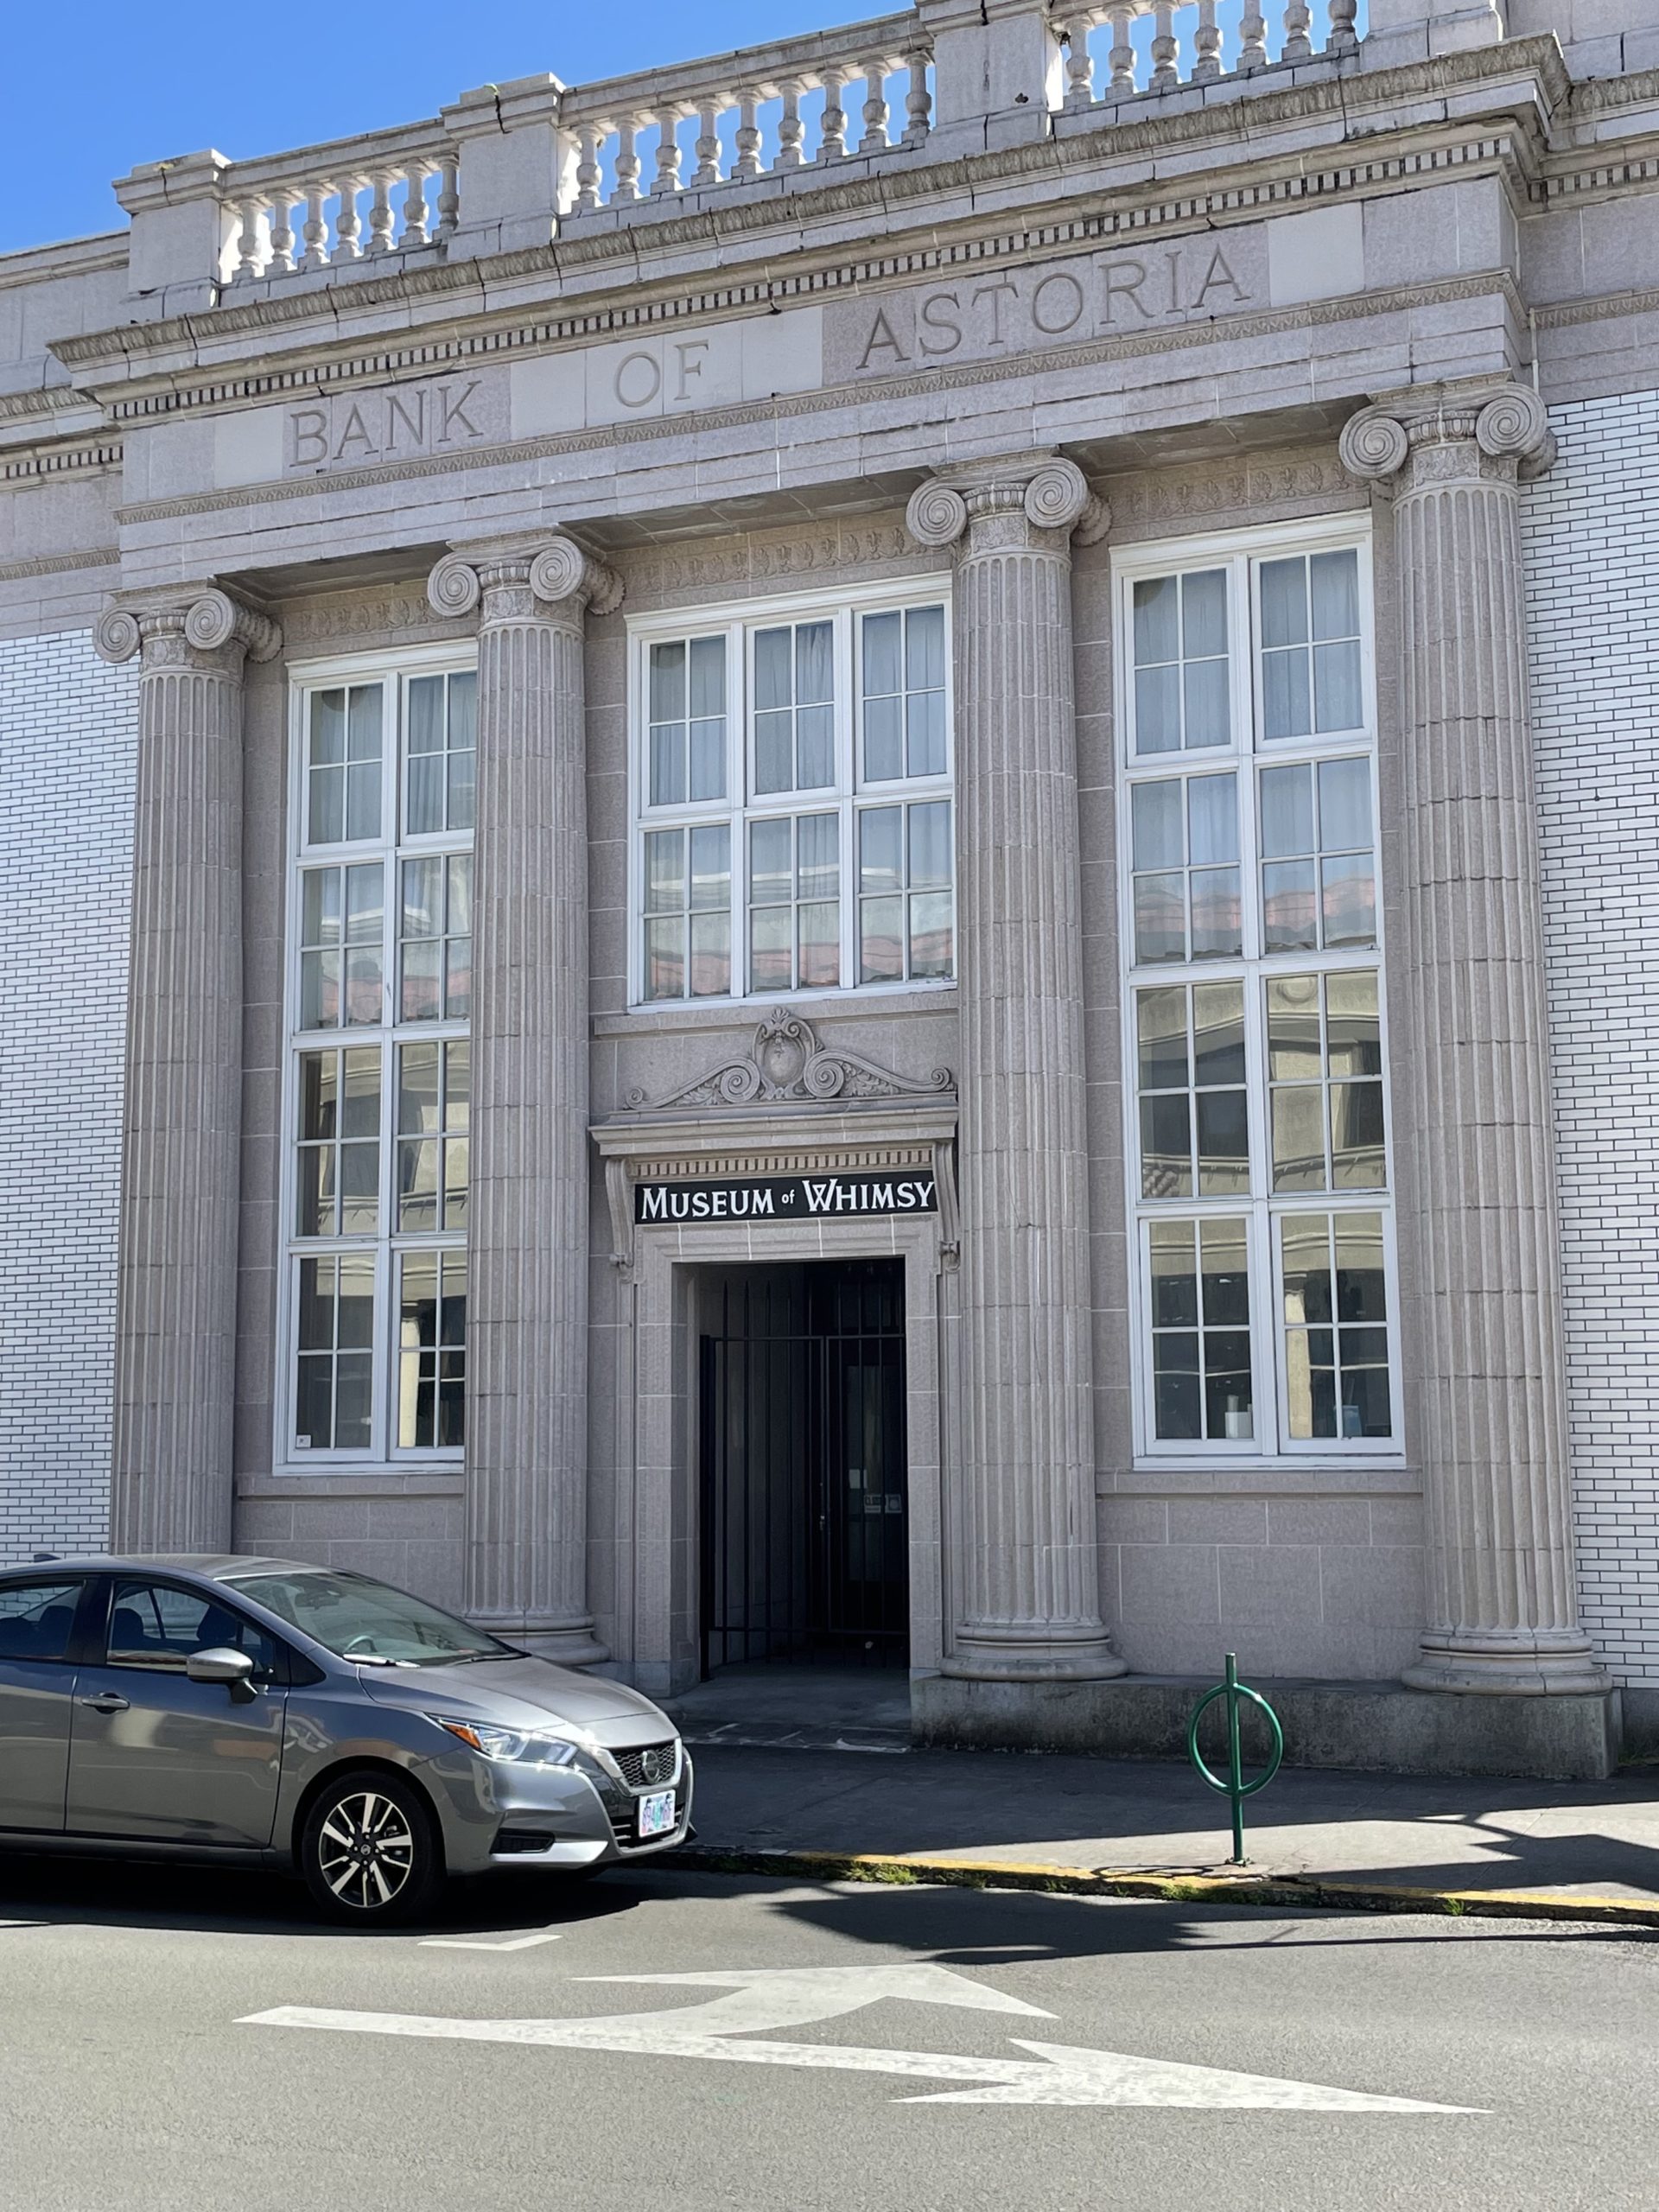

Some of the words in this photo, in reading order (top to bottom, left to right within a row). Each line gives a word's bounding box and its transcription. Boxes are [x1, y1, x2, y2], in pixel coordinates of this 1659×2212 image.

[289, 380, 484, 467] BANK
[613, 339, 709, 408] OF
[855, 243, 1251, 370] ASTORIA
[641, 1187, 775, 1219] MUSEUM
[781, 1189, 795, 1204] of
[802, 1179, 935, 1211] WHIMSY
